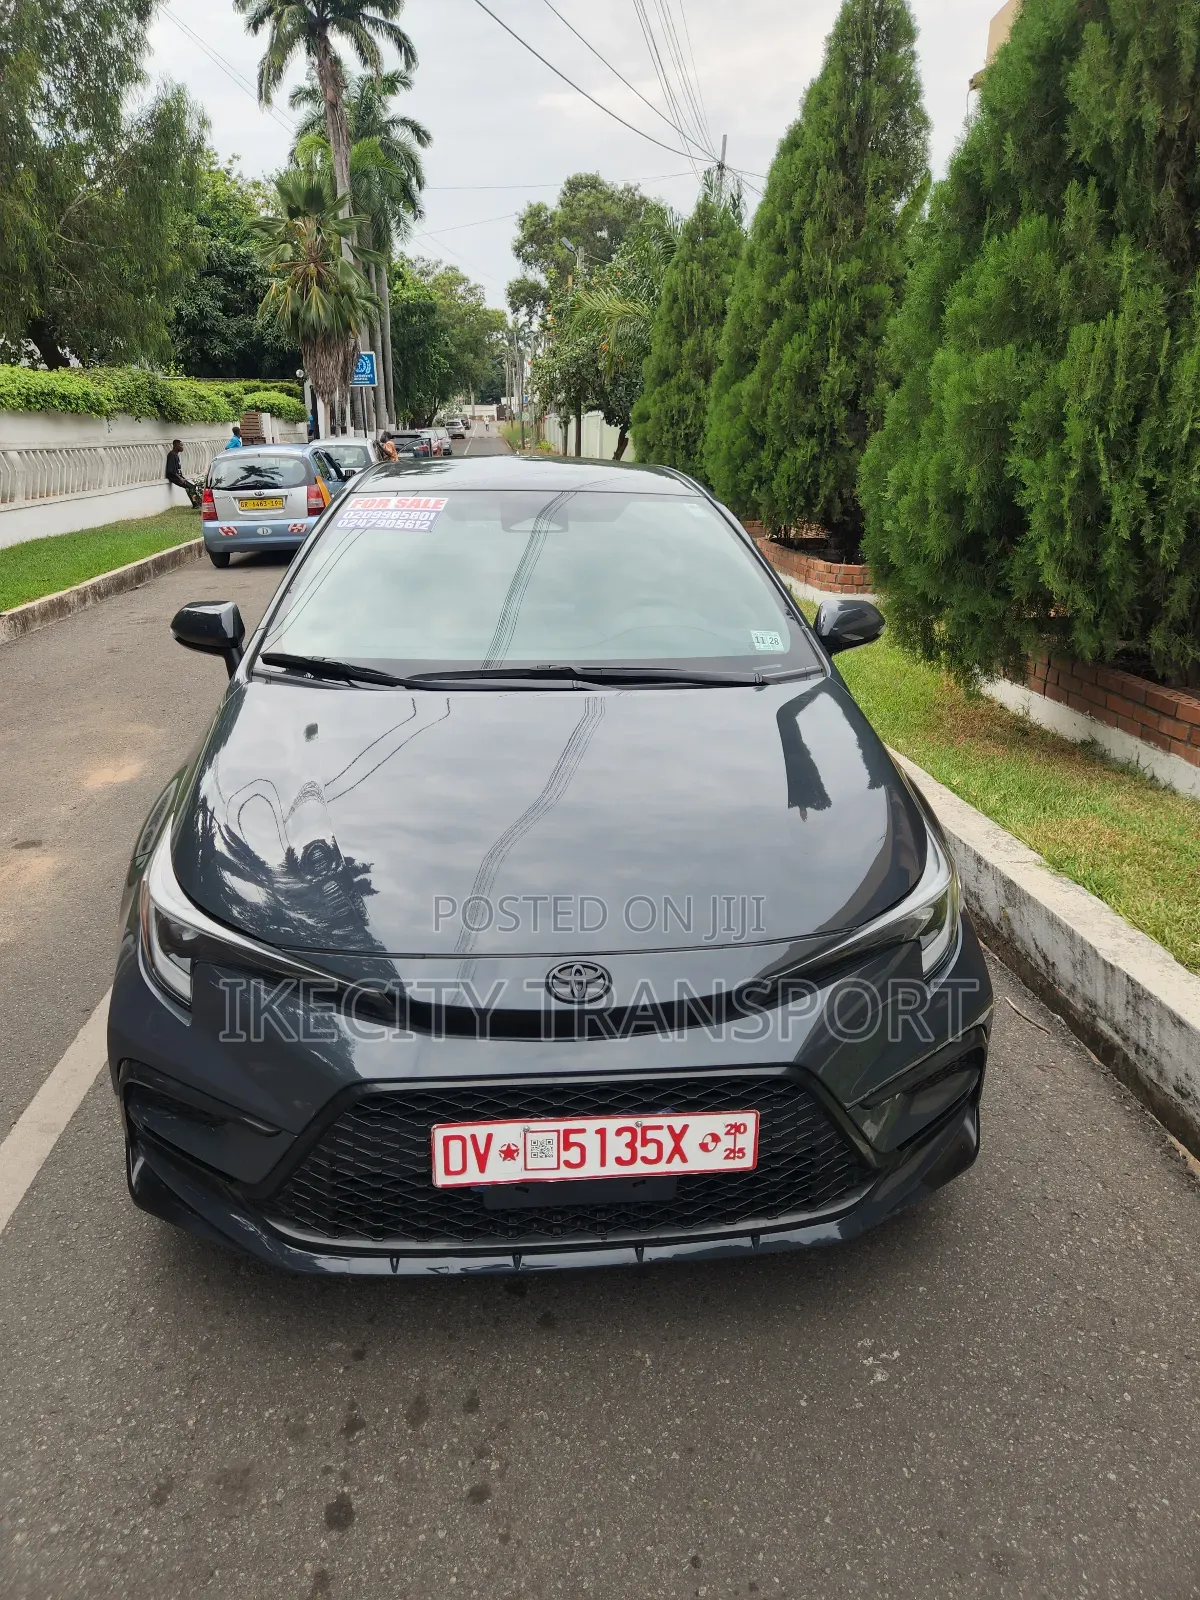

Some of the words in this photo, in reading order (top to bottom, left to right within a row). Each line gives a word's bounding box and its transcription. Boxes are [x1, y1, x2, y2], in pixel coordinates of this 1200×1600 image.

[350, 498, 391, 509] FOR
[393, 498, 446, 510] SALE
[755, 636, 766, 645] 11
[769, 637, 780, 646] 28
[442, 1132, 494, 1176] DV
[562, 1123, 690, 1169] 5135X
